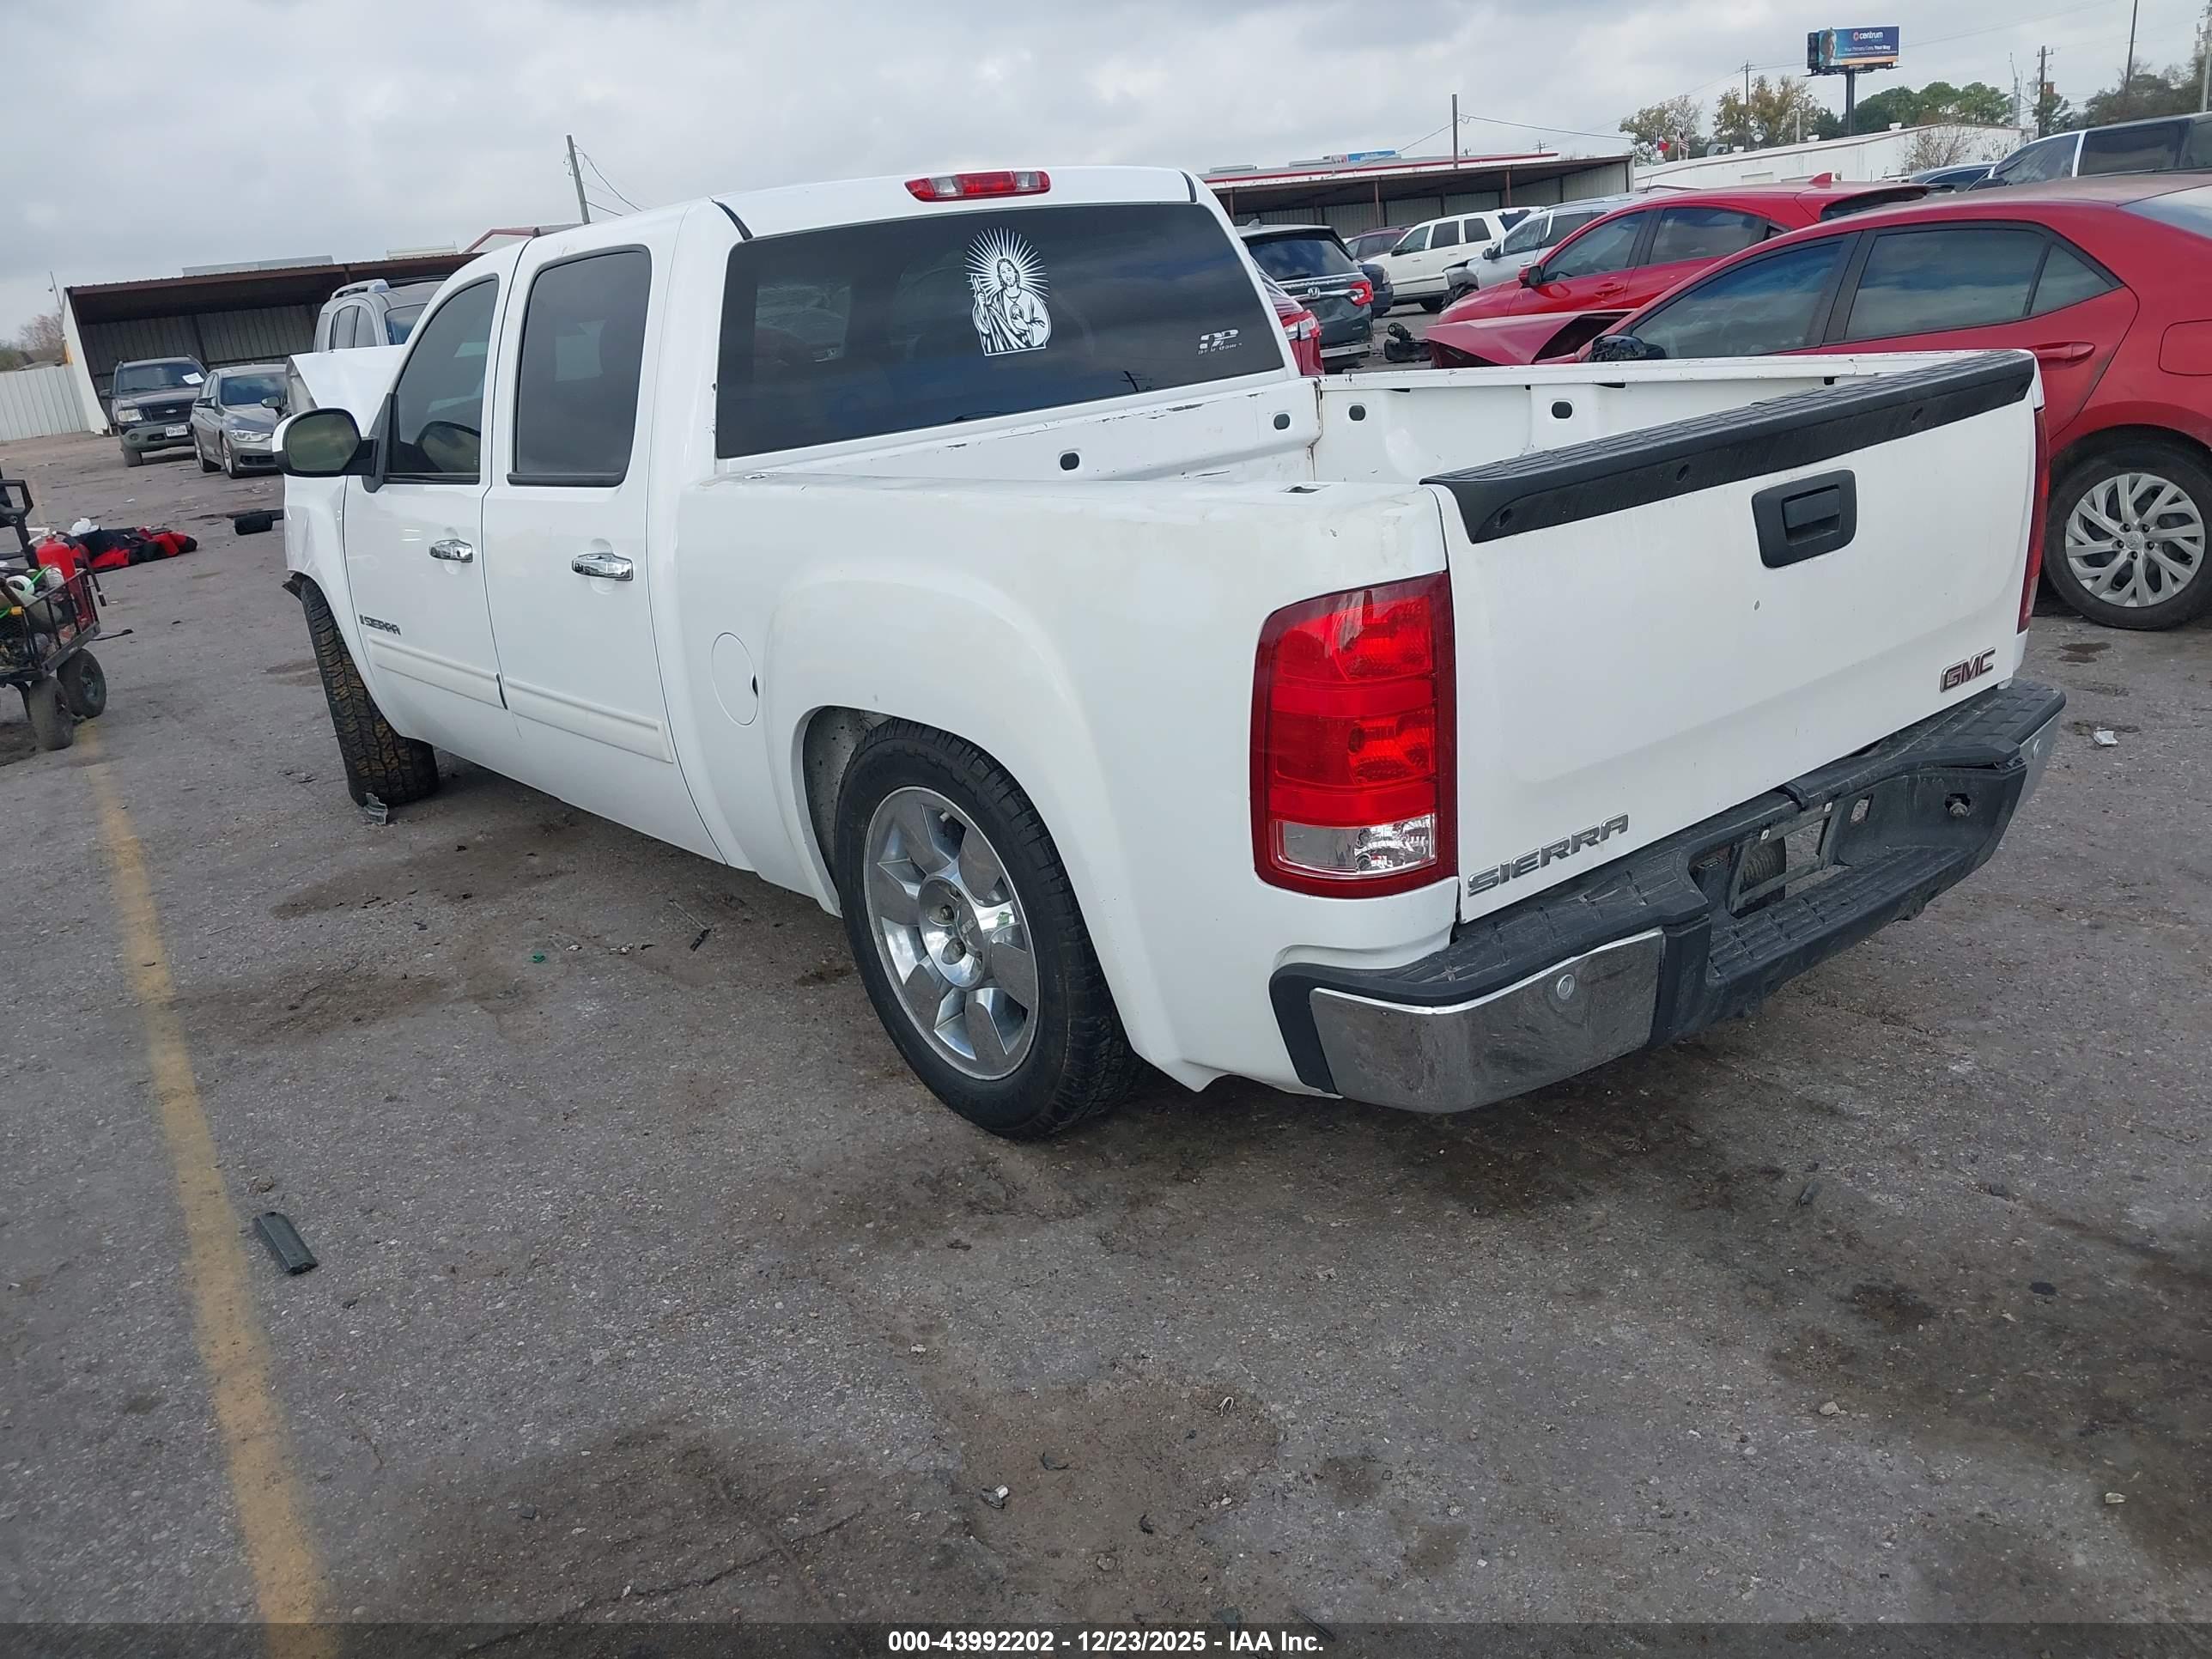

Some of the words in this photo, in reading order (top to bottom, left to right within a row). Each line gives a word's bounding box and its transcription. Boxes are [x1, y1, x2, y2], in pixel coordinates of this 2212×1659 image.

[1859, 31, 1883, 40] centrum
[363, 615, 401, 635] SIERRA
[1940, 647, 1996, 693] GMC
[1468, 811, 1629, 897] SIERRA
